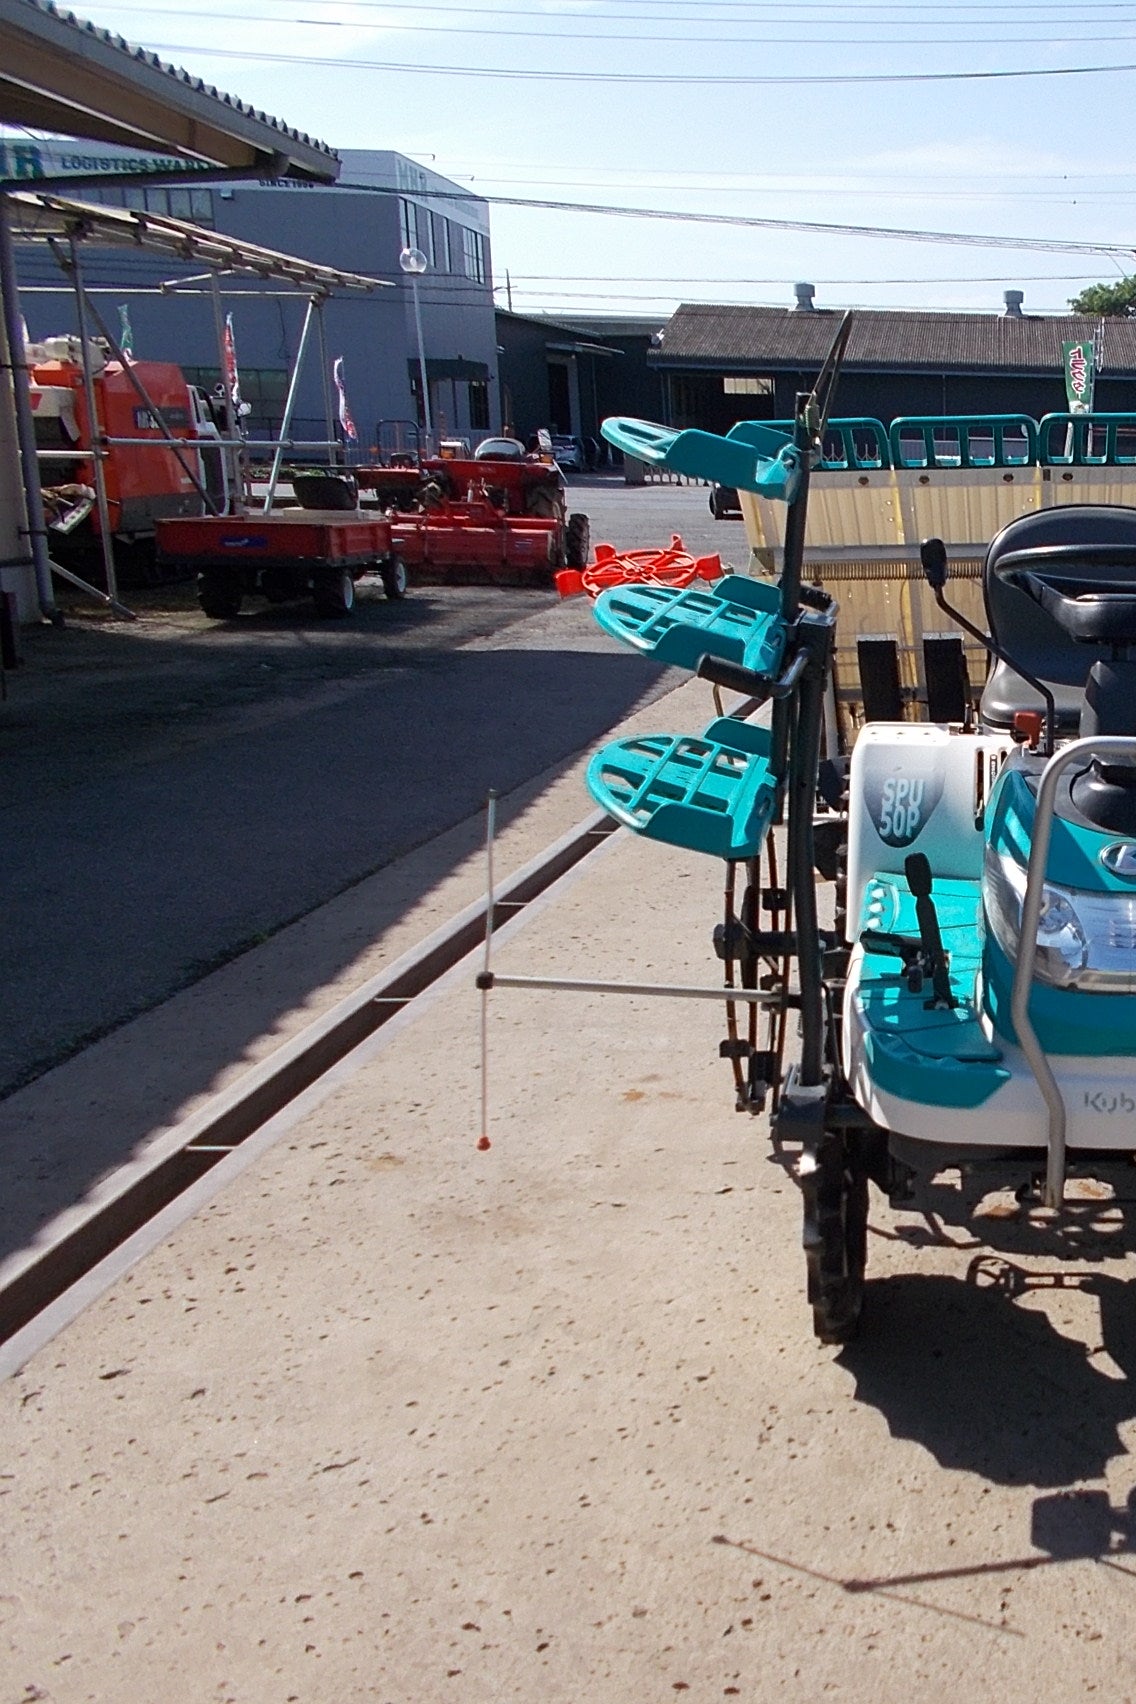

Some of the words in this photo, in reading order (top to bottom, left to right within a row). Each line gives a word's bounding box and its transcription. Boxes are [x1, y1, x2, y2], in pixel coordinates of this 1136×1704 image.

[61, 154, 148, 171] LOGISTICS
[881, 778, 926, 808] SPU
[879, 805, 921, 838] 50P
